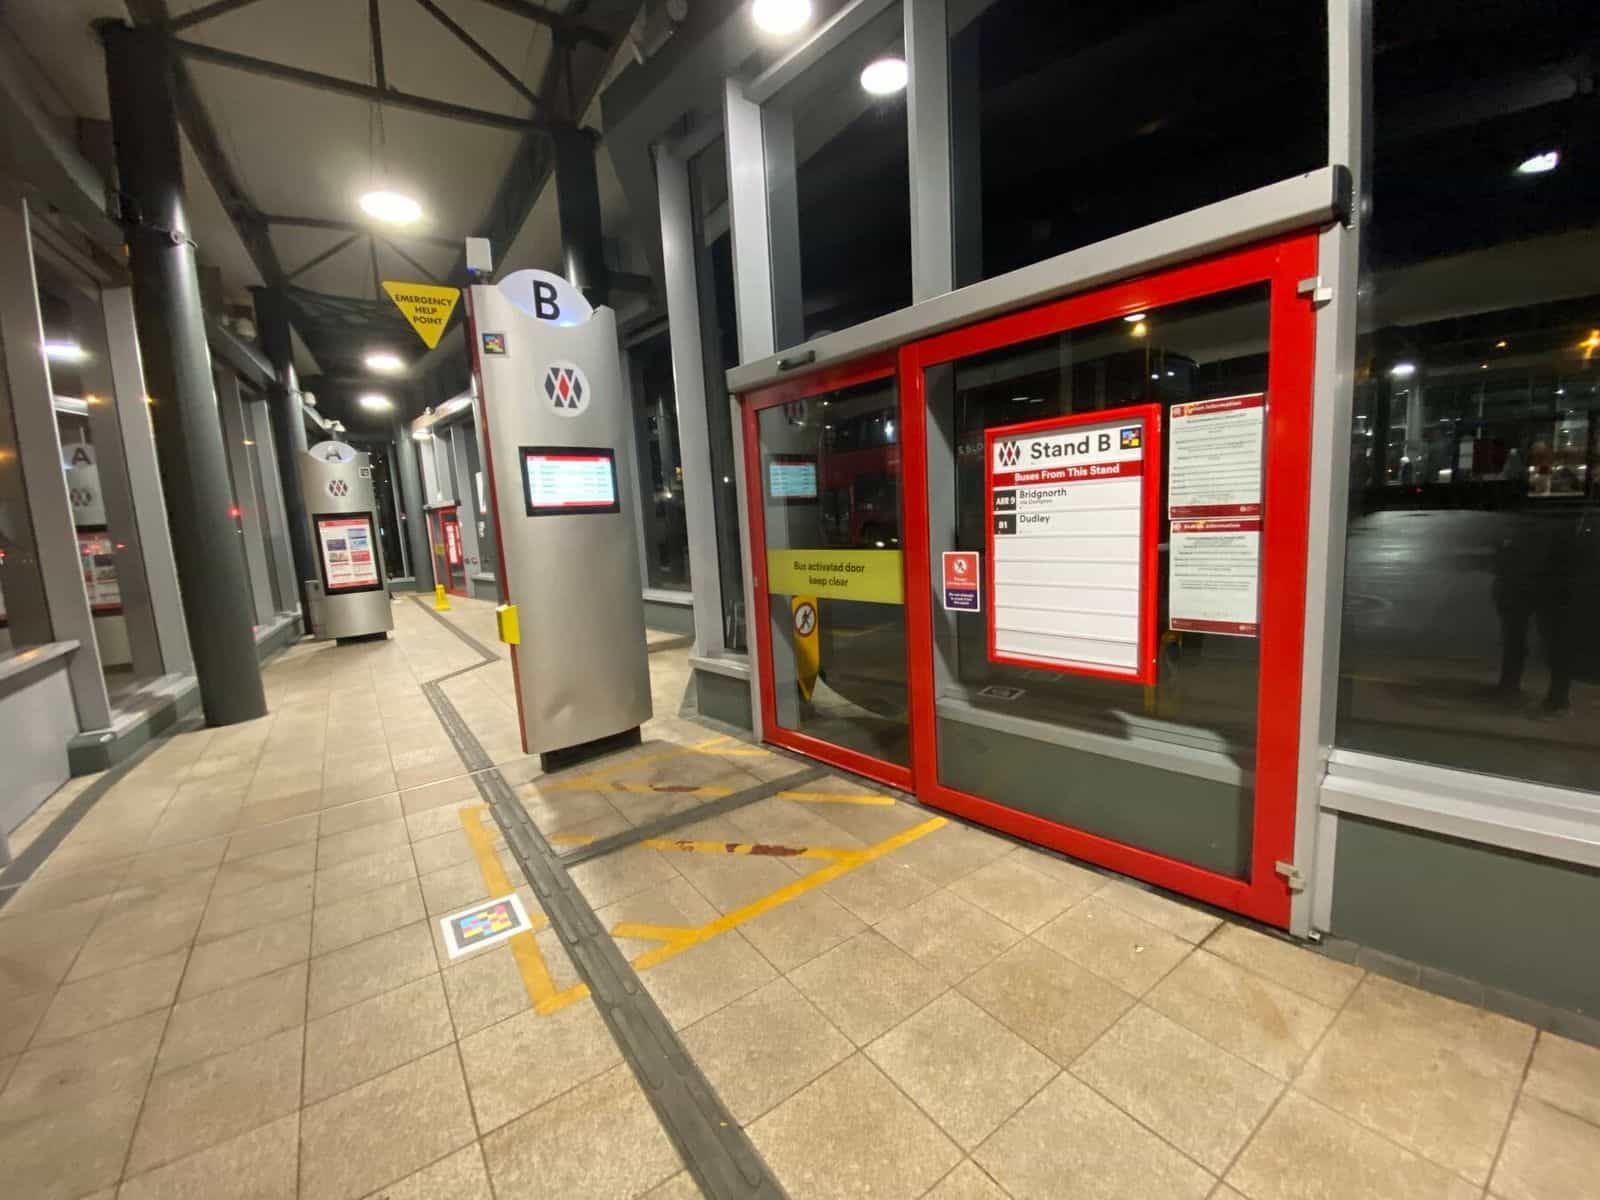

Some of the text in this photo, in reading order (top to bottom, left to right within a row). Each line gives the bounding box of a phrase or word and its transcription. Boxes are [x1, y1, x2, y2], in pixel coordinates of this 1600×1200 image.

[395, 294, 452, 307] EMERGENCY
[533, 280, 560, 320] B
[414, 306, 438, 315] HELP
[413, 315, 443, 326] POINT
[1031, 434, 1111, 460] Stand B
[1015, 463, 1120, 482] Buses From This Stand
[1020, 488, 1067, 500] Bridgnorth
[1019, 514, 1050, 524] Dudley
[794, 561, 865, 573] Bus activated door
[808, 576, 849, 588] keep clear
